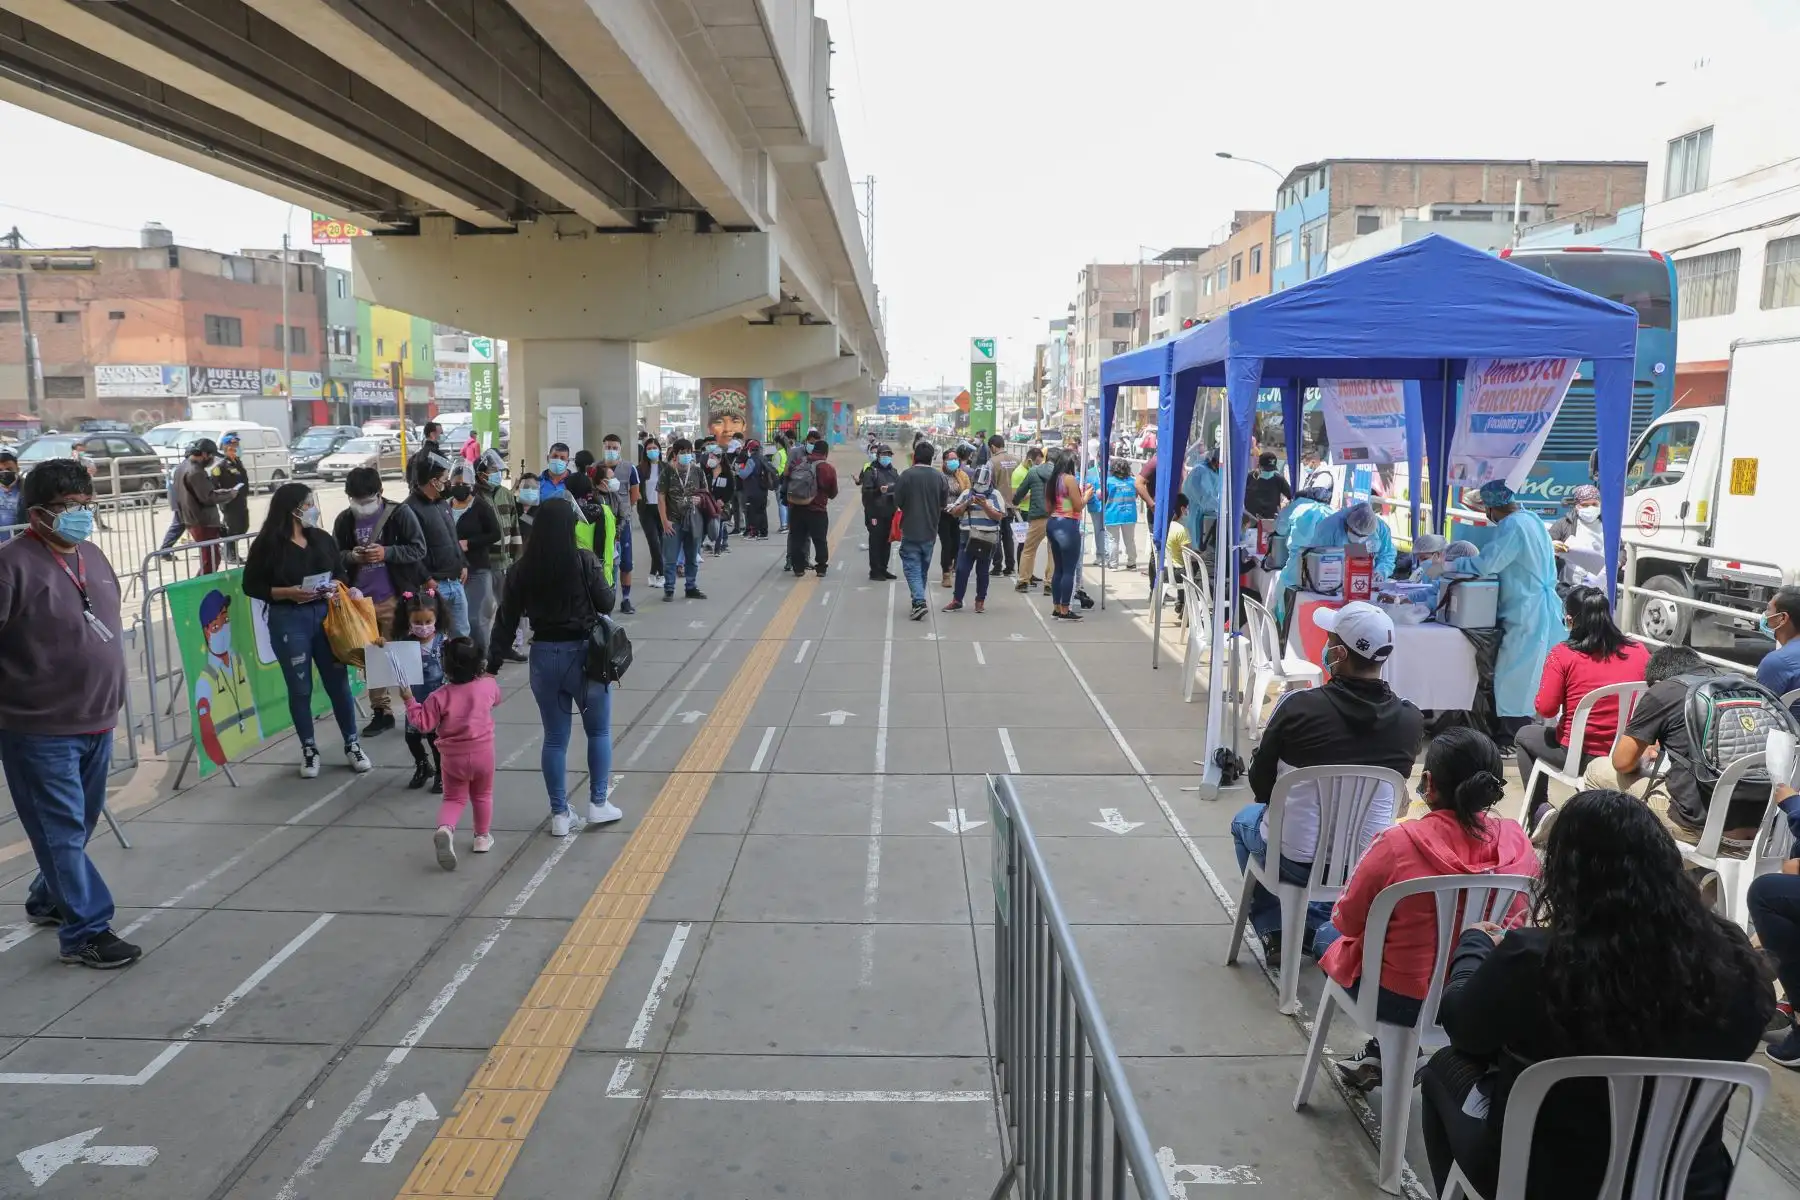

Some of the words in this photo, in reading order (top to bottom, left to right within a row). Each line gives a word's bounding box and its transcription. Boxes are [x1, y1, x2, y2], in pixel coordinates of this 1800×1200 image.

[207, 367, 260, 381] MUELLES
[482, 369, 492, 394] Lima
[983, 369, 993, 394] Lima
[207, 379, 260, 390] CASAS
[474, 380, 483, 411] Metro
[483, 397, 492, 410] de
[974, 381, 984, 412] Metro
[984, 398, 993, 411] de
